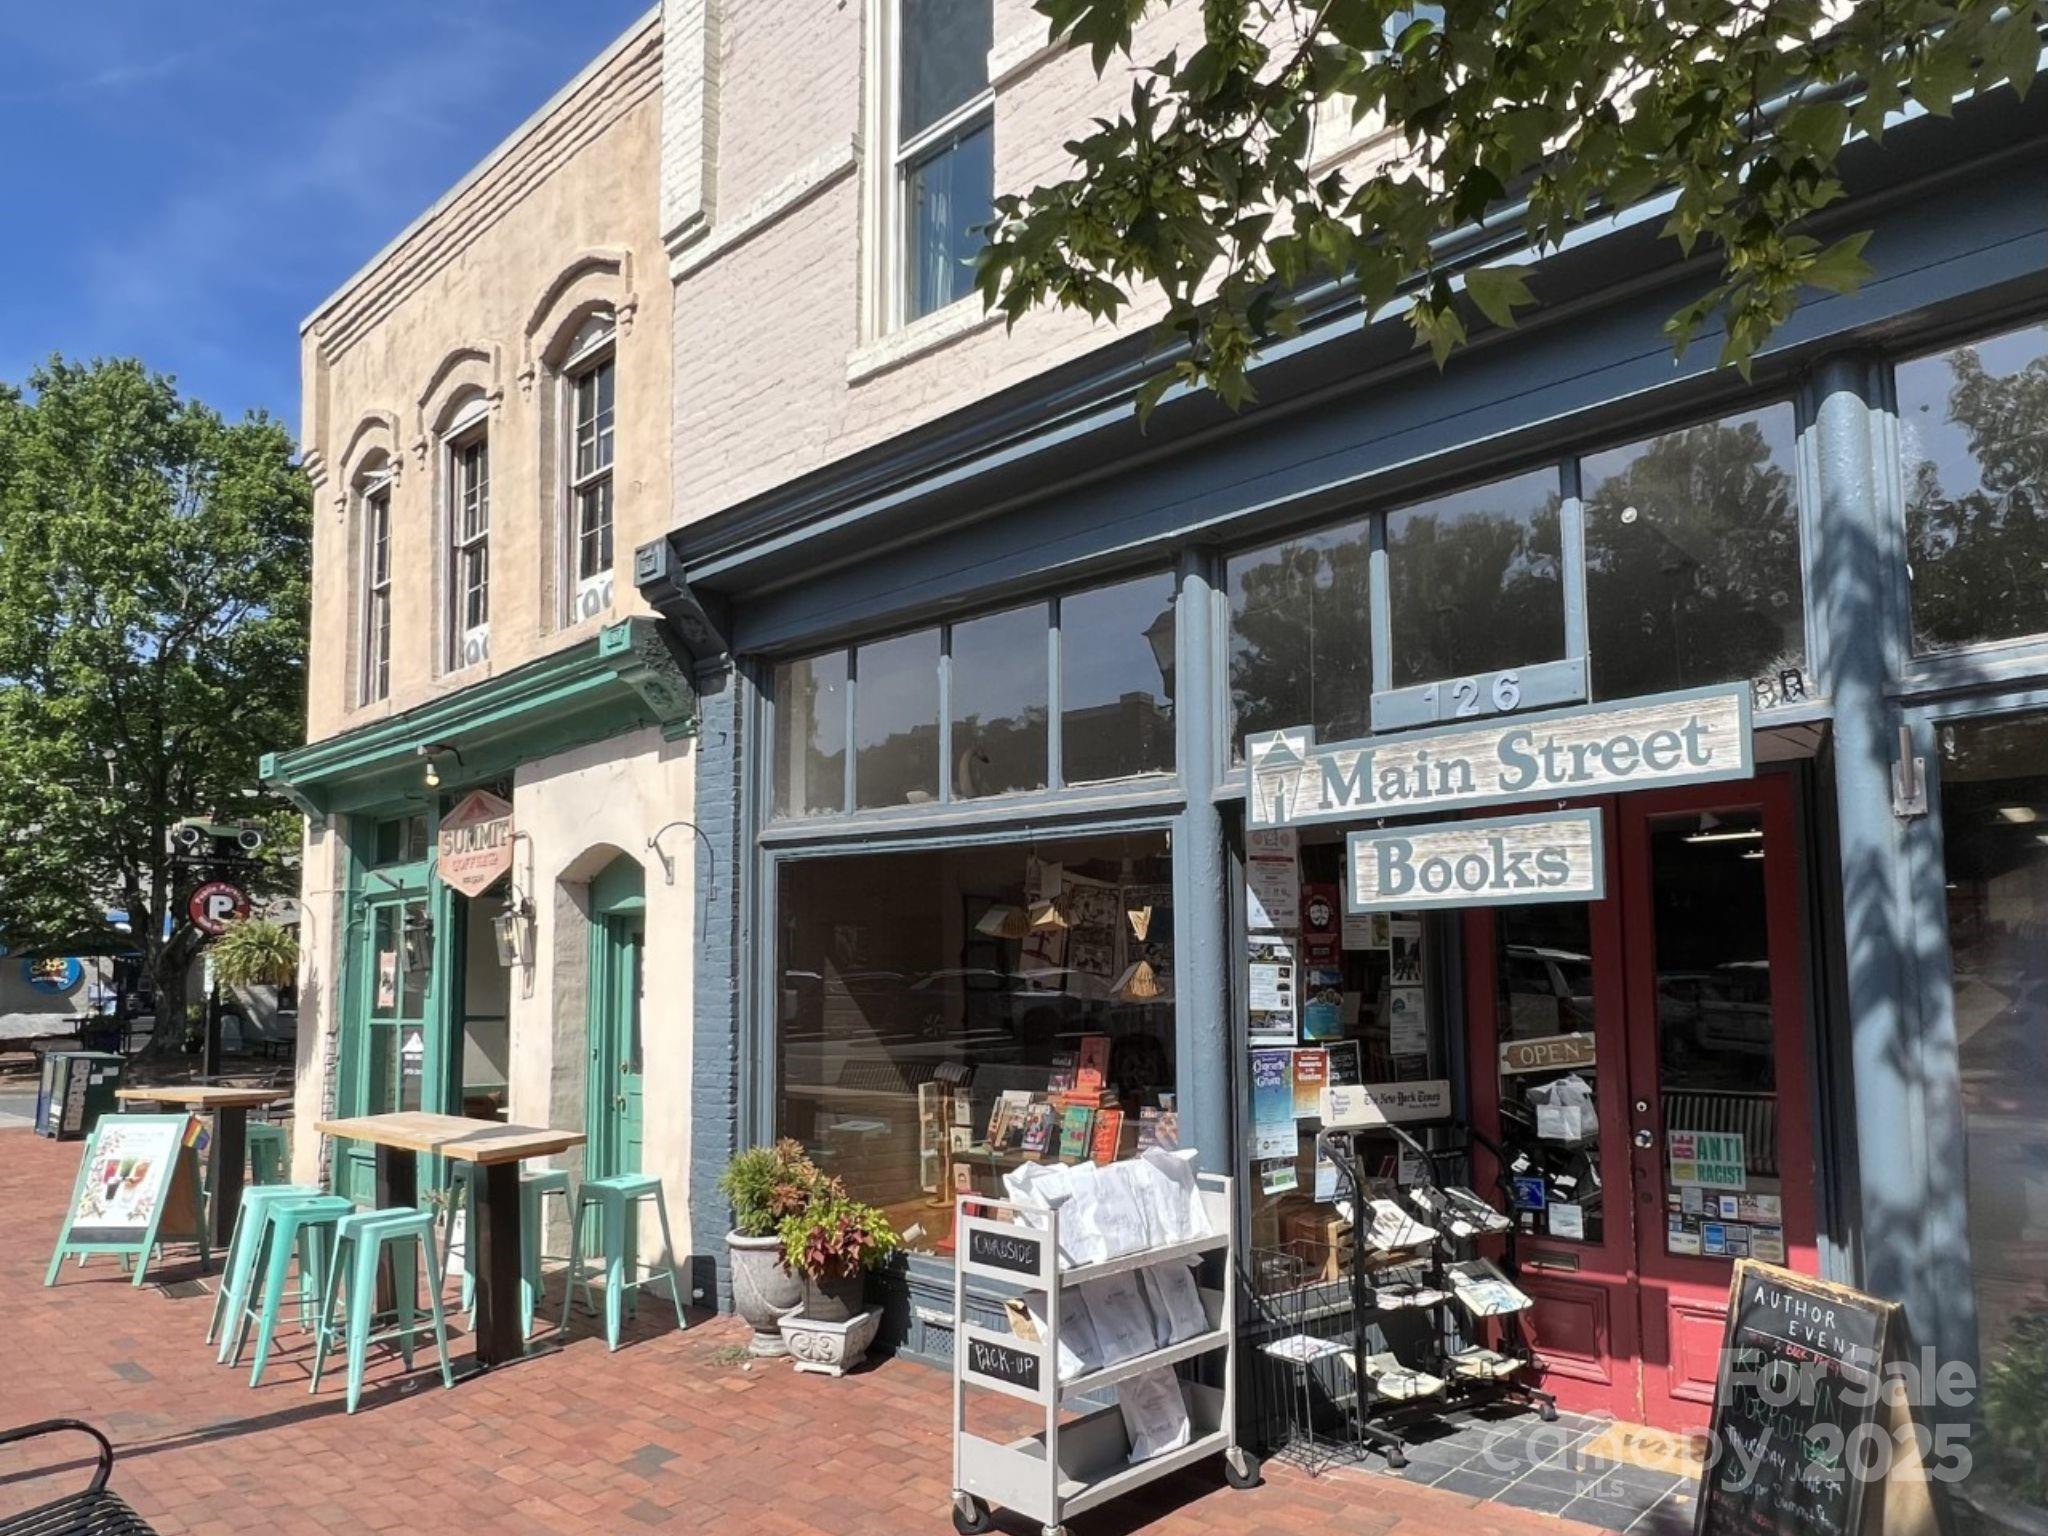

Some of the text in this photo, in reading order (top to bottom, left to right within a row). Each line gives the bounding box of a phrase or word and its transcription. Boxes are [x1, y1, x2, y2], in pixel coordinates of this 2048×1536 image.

[1424, 669, 1520, 720] 126
[1317, 715, 1712, 809] Main Street
[444, 821, 508, 857] SUMMIT
[1373, 837, 1571, 896] Books
[209, 895, 234, 920] P
[1521, 1043, 1579, 1065] OPEN
[1380, 1092, 1398, 1104] New
[1398, 1091, 1416, 1107] York
[1417, 1090, 1441, 1103] Times
[1697, 1136, 1742, 1162] ANTI
[1697, 1163, 1743, 1185] RACIST
[974, 1234, 1033, 1264] CURBSIDE
[975, 1344, 1034, 1375] PICK-UP
